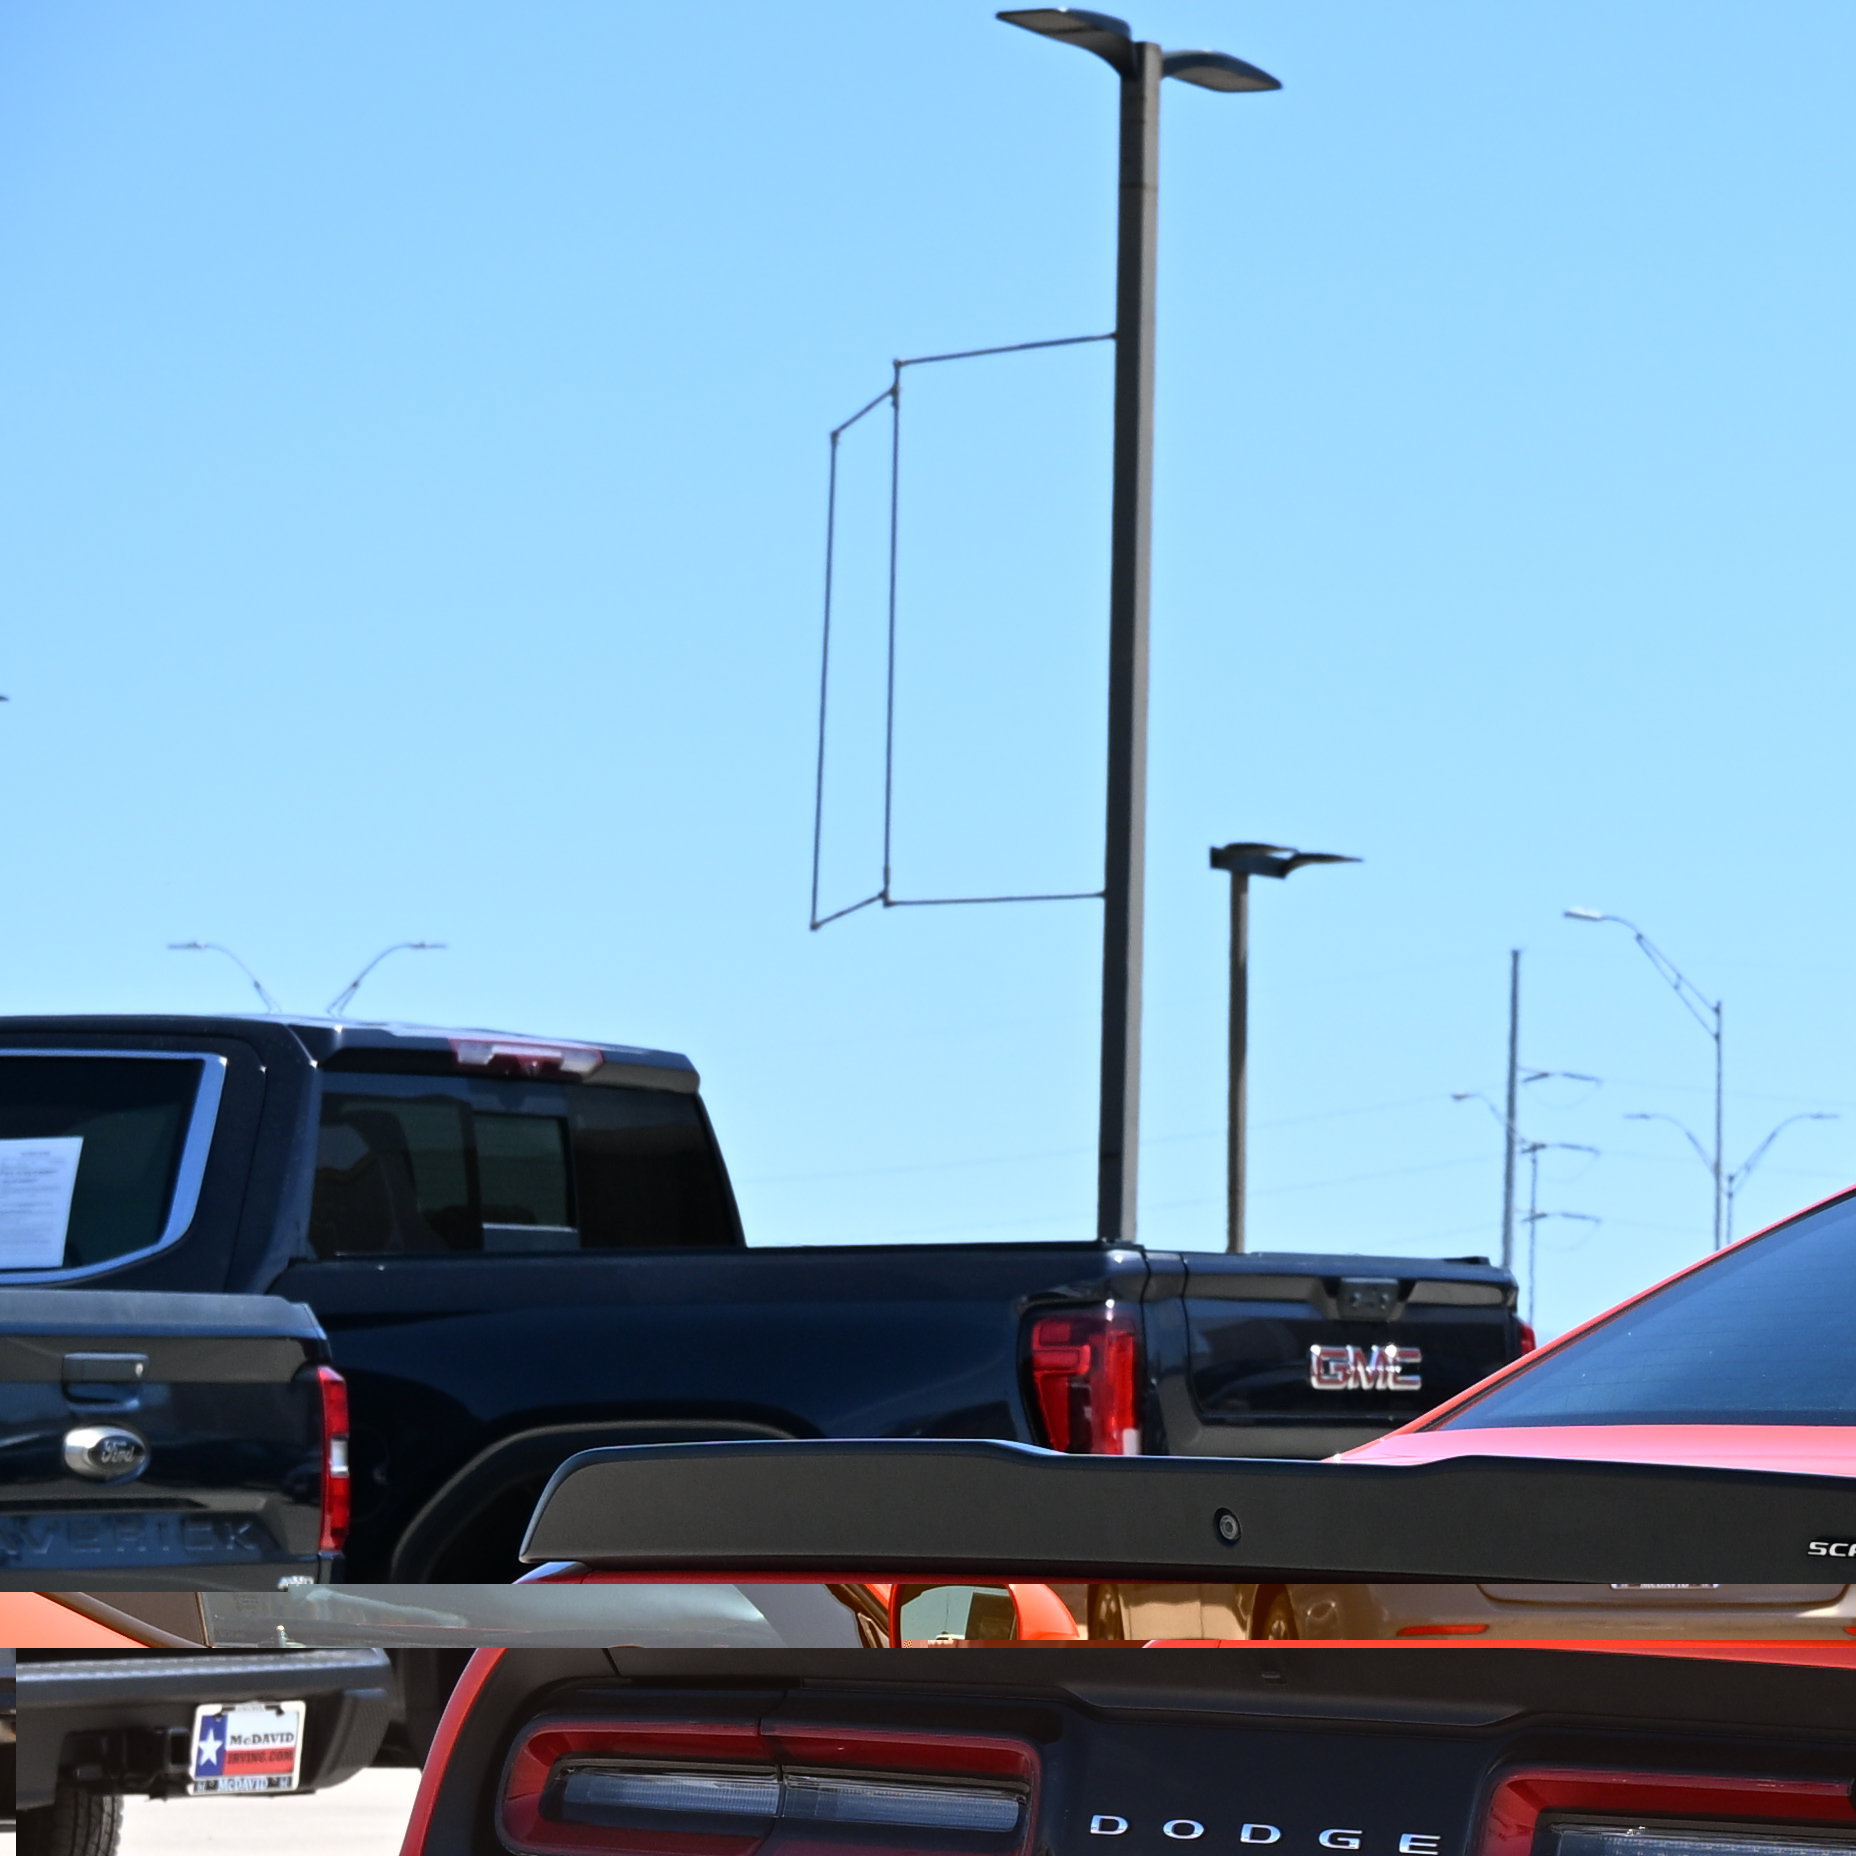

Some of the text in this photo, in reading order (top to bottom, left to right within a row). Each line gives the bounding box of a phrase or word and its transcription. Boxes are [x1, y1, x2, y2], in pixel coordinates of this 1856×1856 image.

[1310, 1344, 1422, 1390] GMC
[101, 1440, 136, 1463] Ford
[230, 1732, 295, 1746] McDAVID
[1090, 1814, 1443, 1856] DODGE
